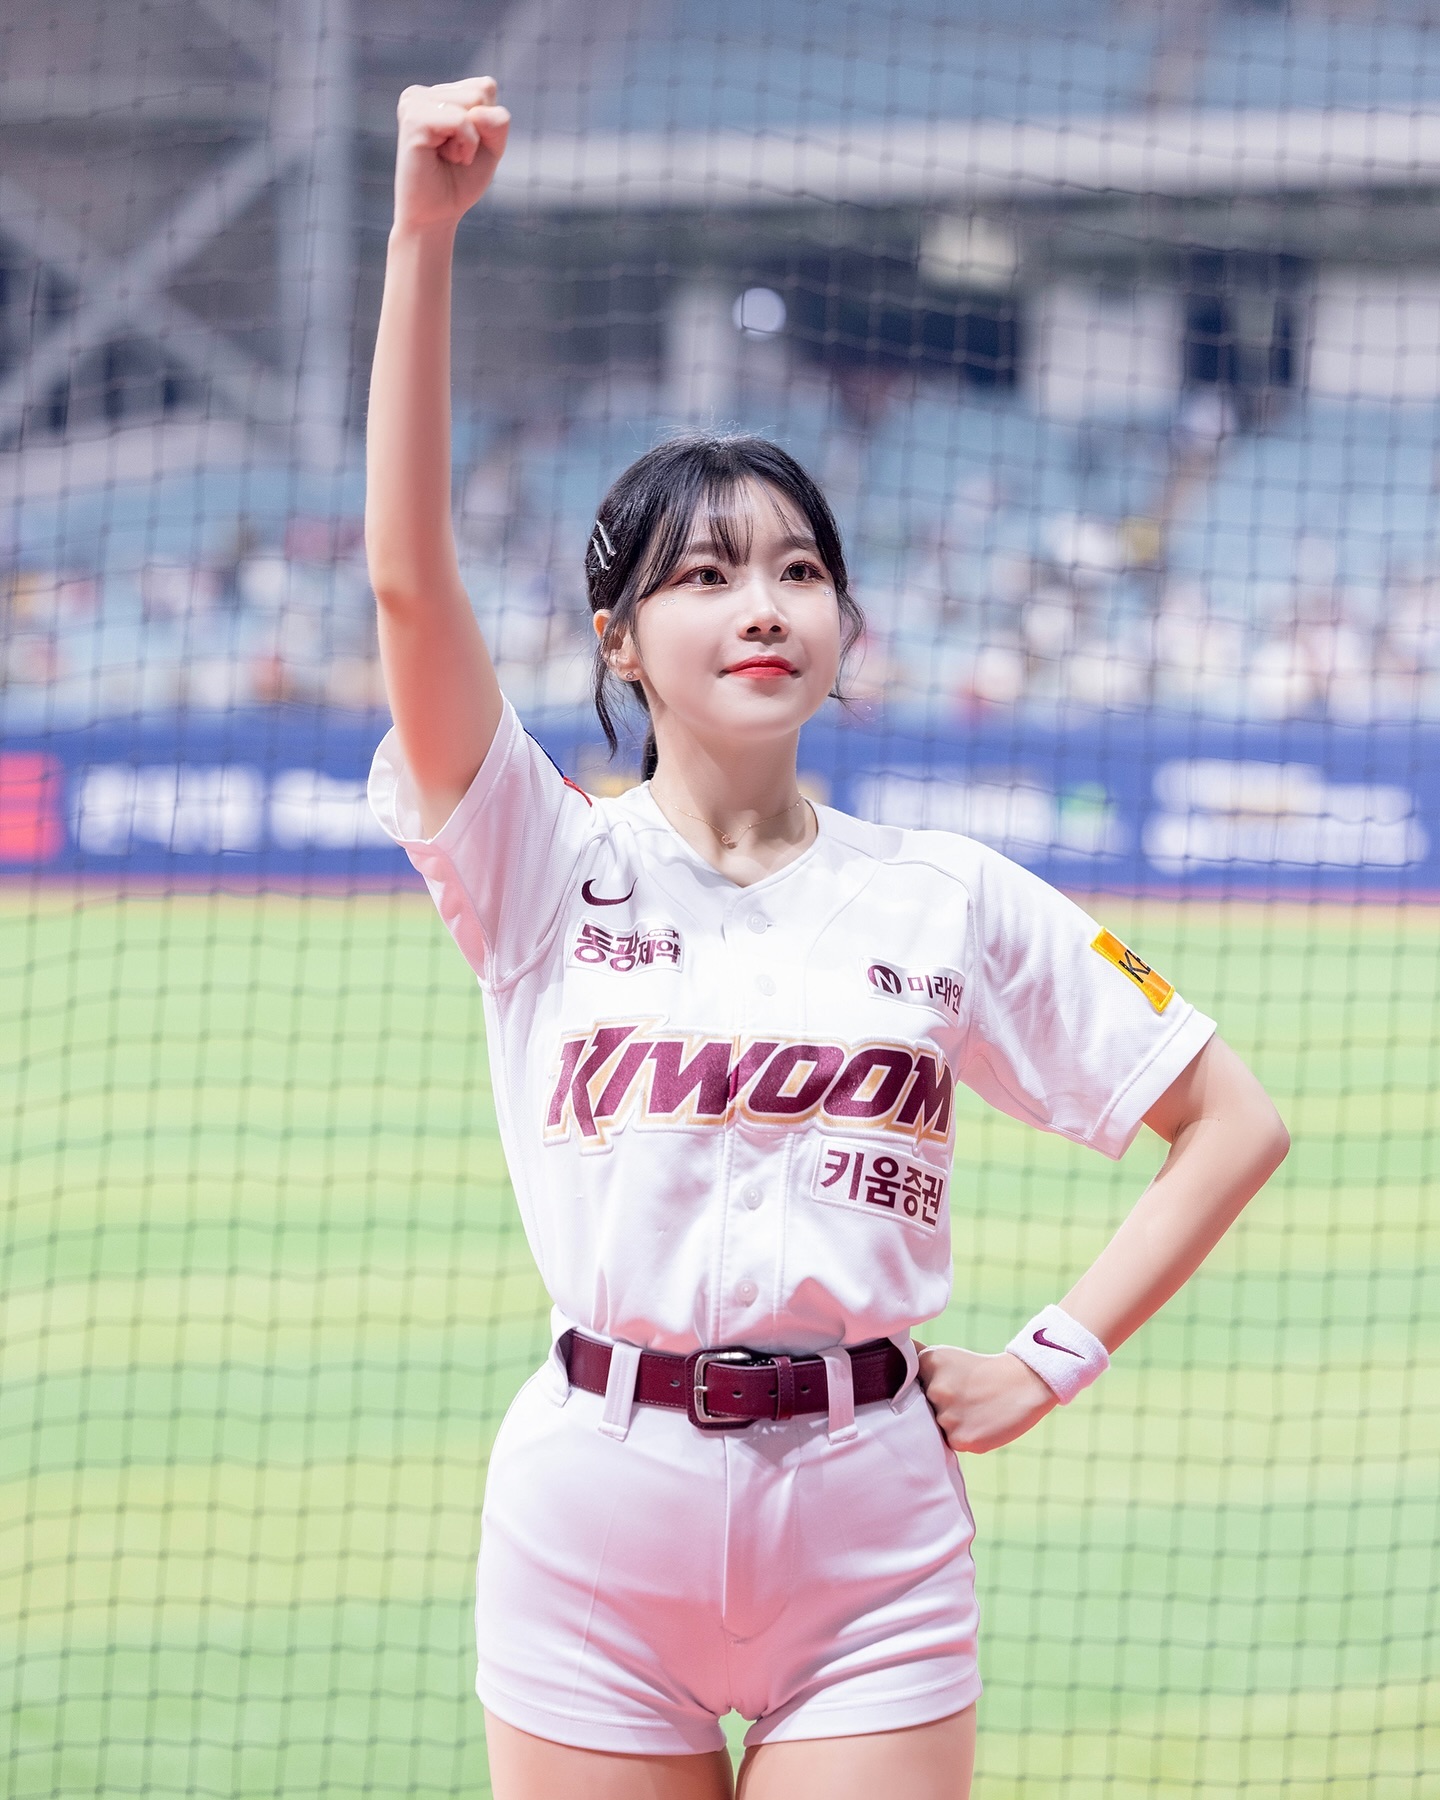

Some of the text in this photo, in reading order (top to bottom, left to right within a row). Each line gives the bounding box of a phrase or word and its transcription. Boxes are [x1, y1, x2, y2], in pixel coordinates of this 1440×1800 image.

[574, 923, 681, 972] 동광제약
[545, 1023, 953, 1139] KIWOOM
[820, 1149, 944, 1227] 키움증권
